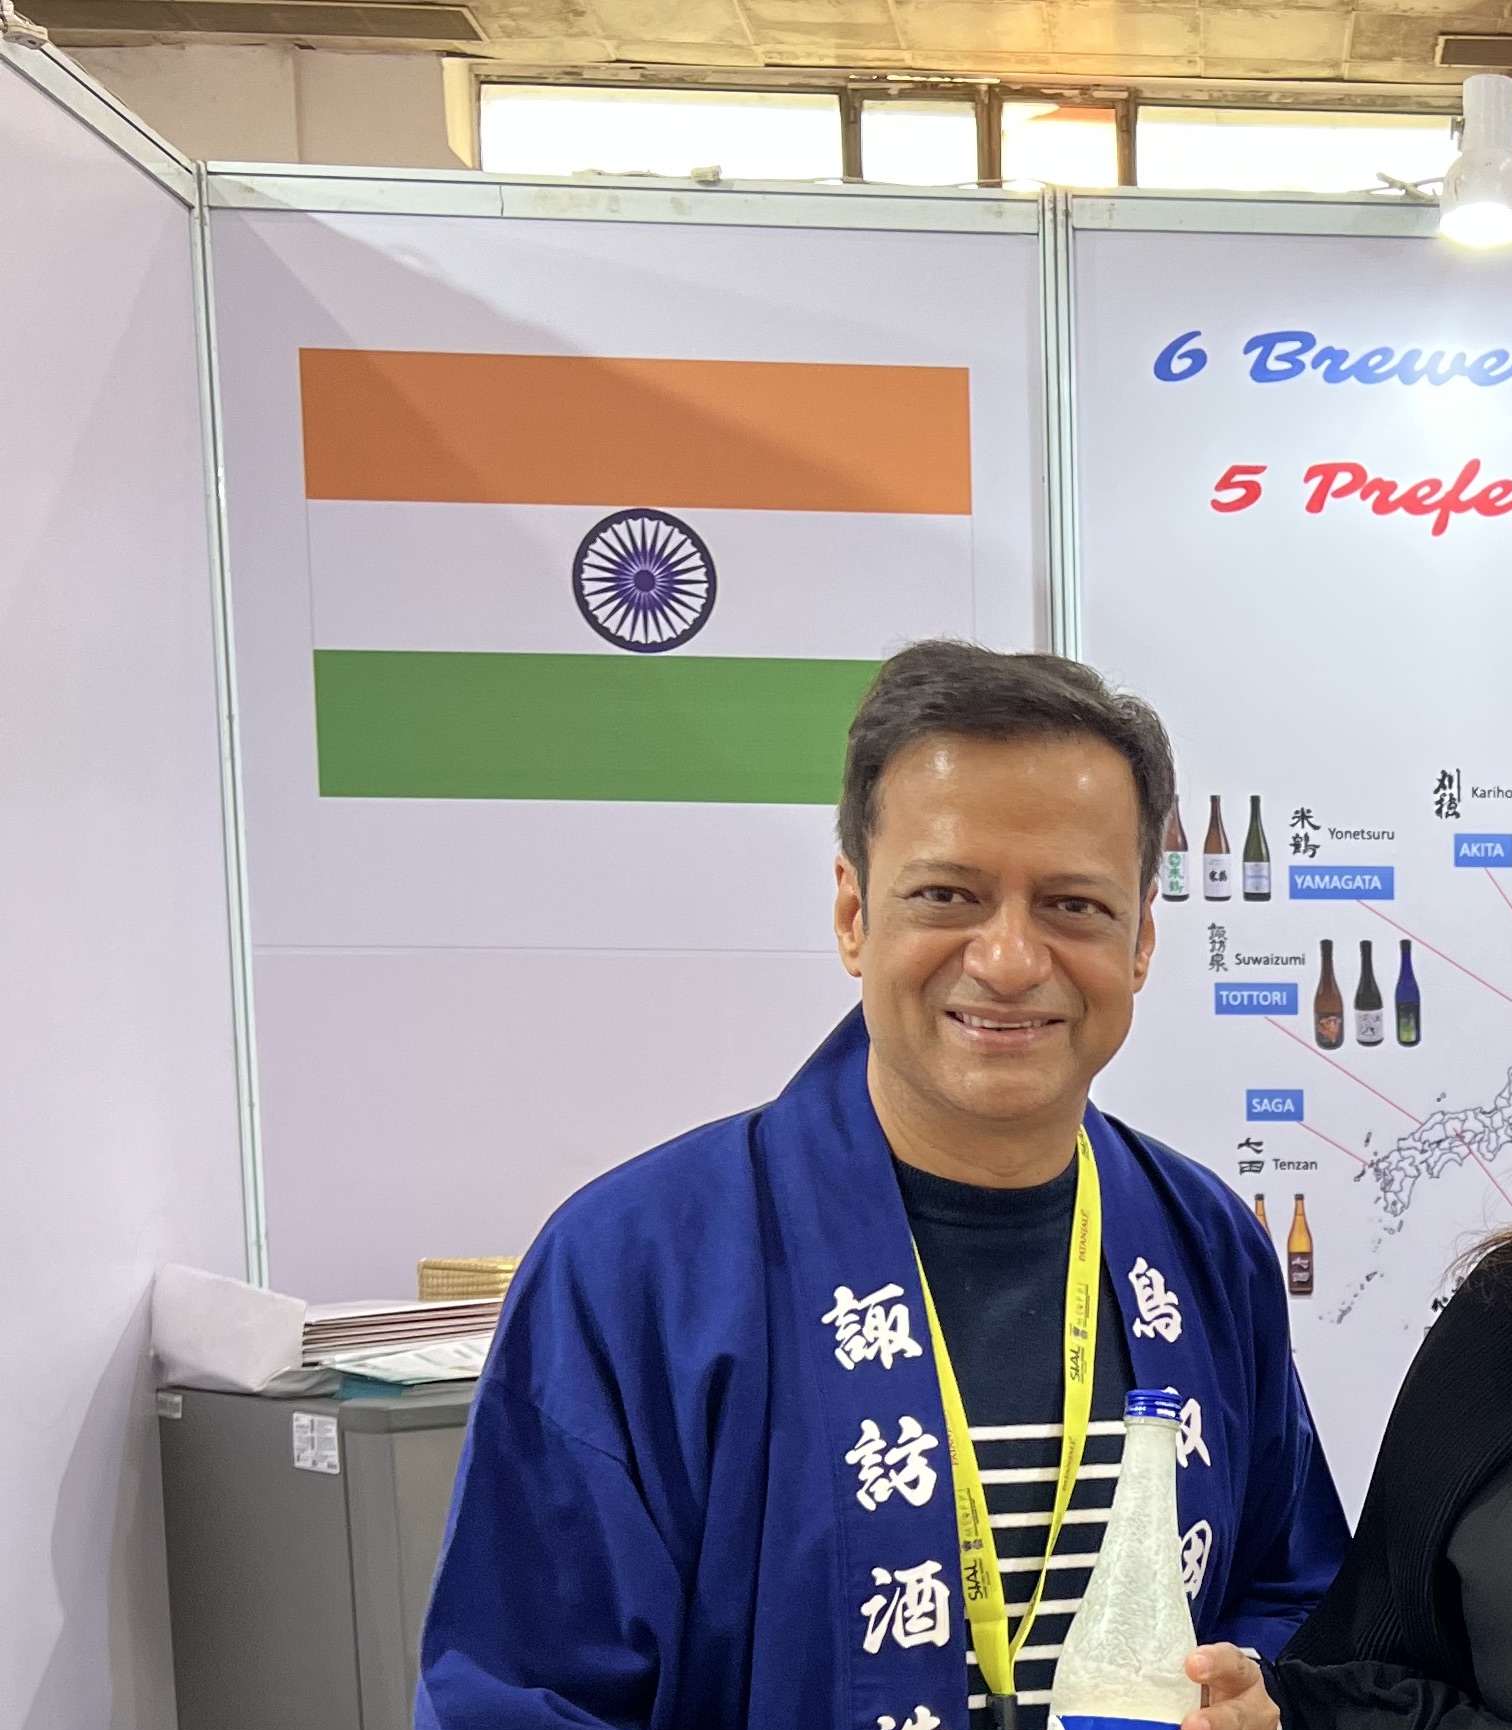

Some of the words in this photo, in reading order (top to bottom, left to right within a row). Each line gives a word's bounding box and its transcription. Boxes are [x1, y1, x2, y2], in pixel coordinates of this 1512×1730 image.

[1154, 331, 1207, 382] 6
[1211, 465, 1267, 513] 5
[1471, 786, 1512, 799] Kariho
[1328, 827, 1395, 840] Yonetsuru
[1459, 843, 1504, 858] AKITA
[1294, 875, 1382, 890] YAMAGATA
[1235, 953, 1305, 966] Suwaizumi
[1220, 991, 1287, 1006] TOTTORI
[1252, 1098, 1294, 1113] SAGA
[1273, 1159, 1318, 1171] Tenzan
[1069, 1346, 1082, 1384] SIAL
[964, 1559, 983, 1601] SIAL
